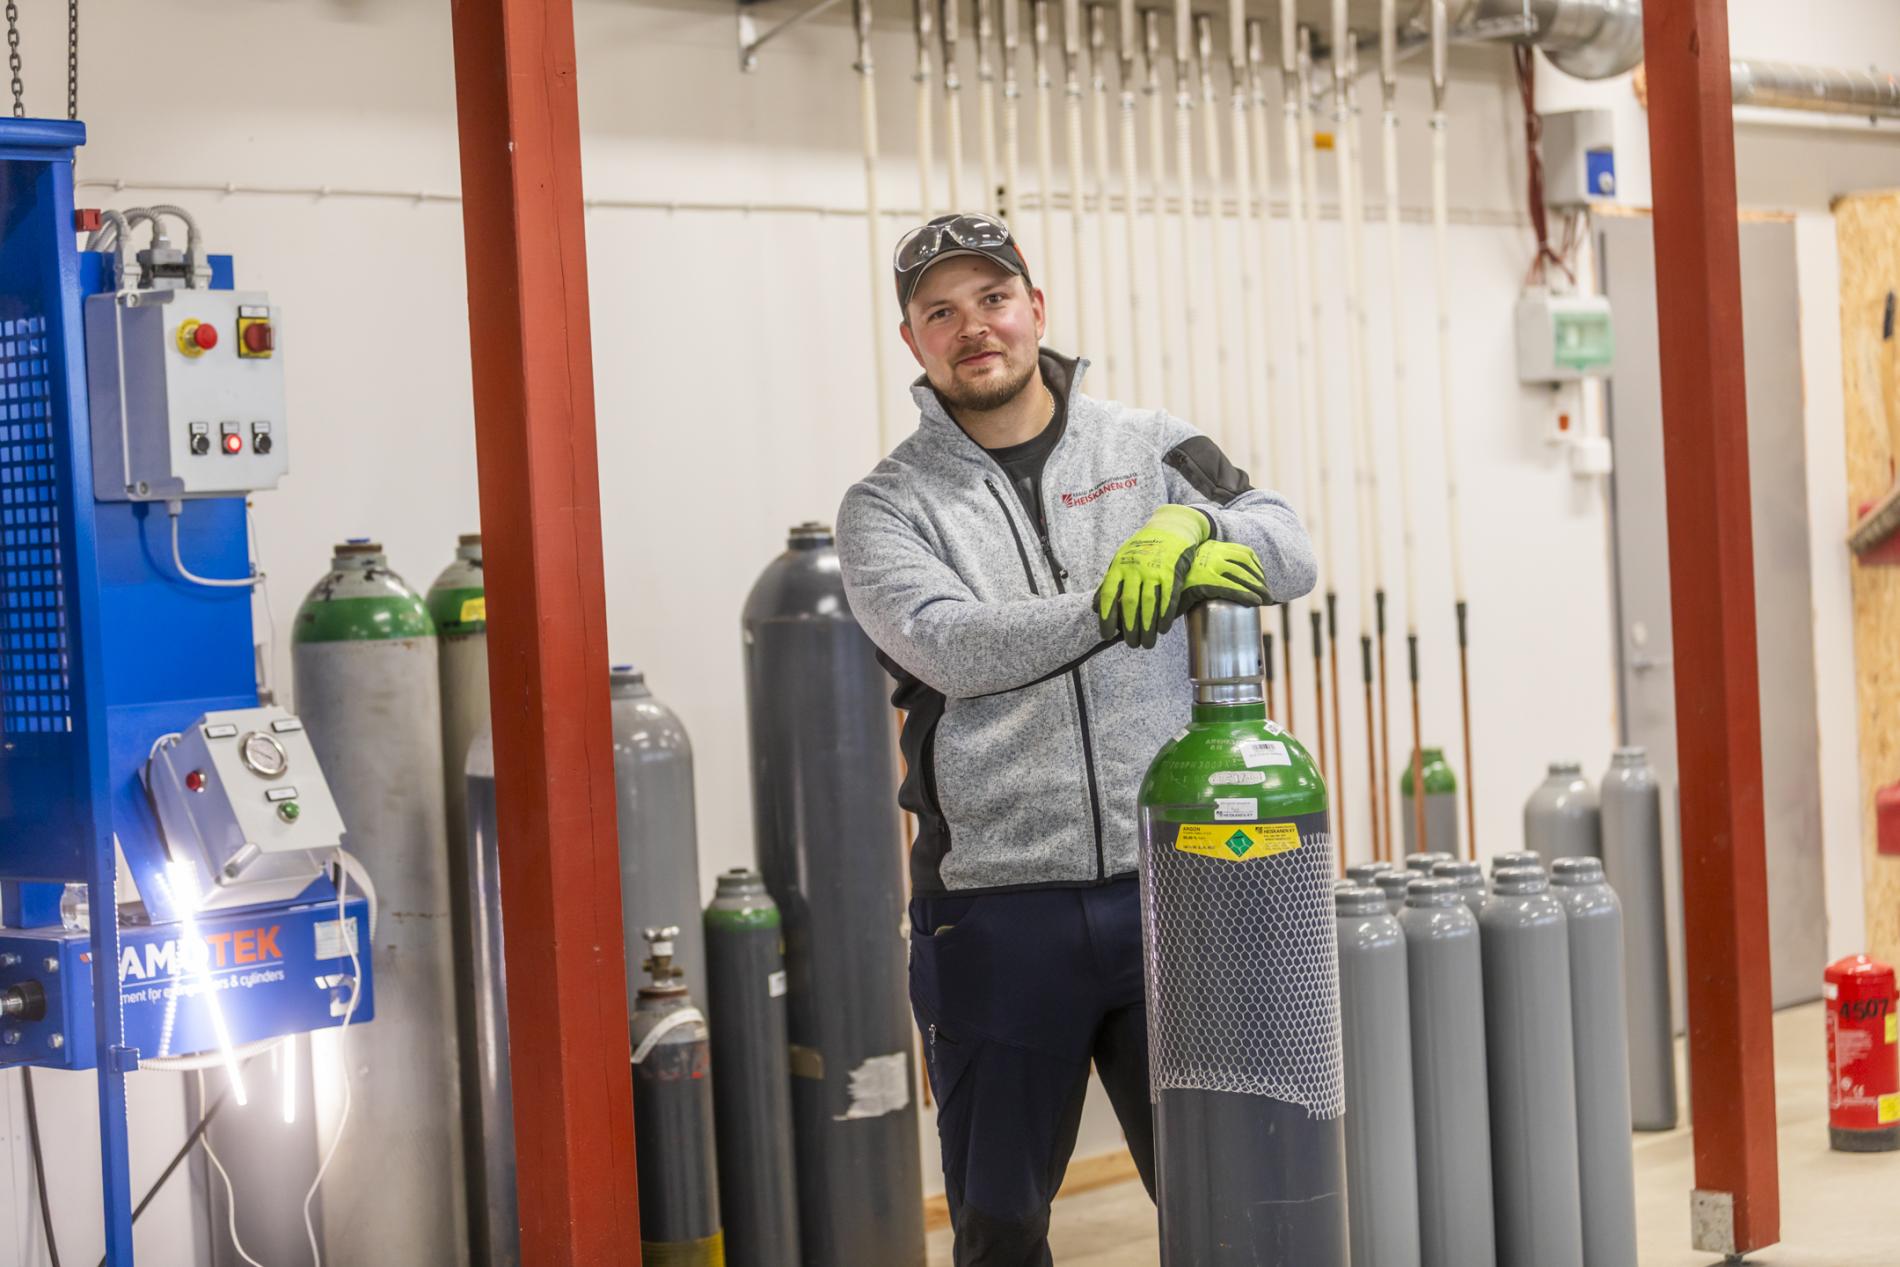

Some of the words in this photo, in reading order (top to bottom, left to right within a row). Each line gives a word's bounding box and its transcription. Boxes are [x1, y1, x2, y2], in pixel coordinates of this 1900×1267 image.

[1073, 482, 1123, 506] HEISKANEN
[1124, 478, 1137, 488] OY
[80, 924, 283, 984] AMOTEK
[148, 987, 162, 1005] for
[230, 974, 239, 988] &
[239, 969, 285, 989] cylinders
[1839, 999, 1889, 1021] 4507
